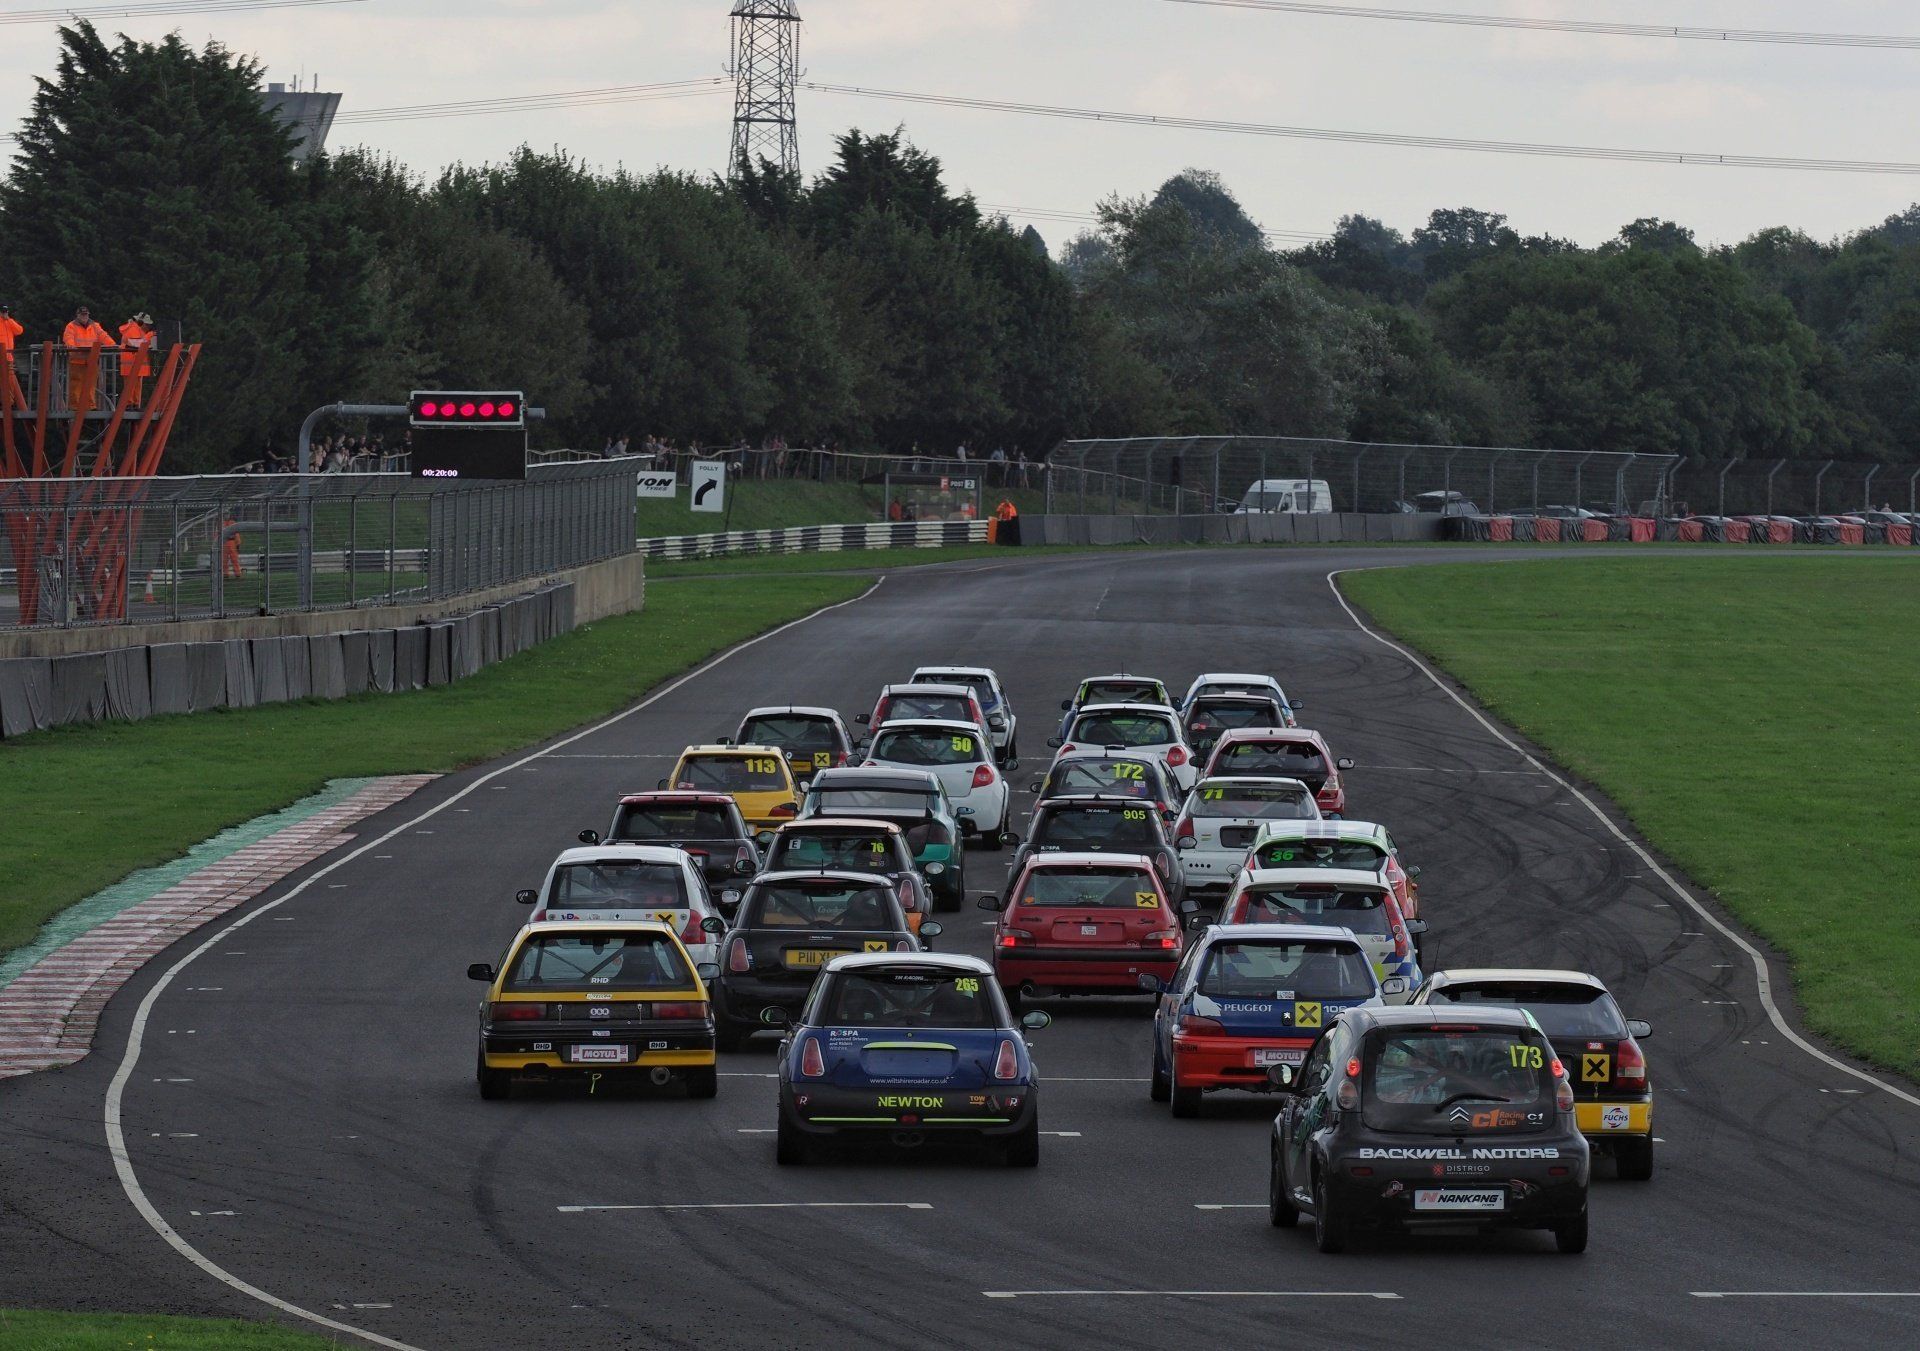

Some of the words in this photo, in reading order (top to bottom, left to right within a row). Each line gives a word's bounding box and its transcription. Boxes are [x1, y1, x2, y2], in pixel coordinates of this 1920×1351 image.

[422, 469, 458, 477] 00:20:00
[952, 737, 972, 753] 50
[745, 758, 776, 774] 113
[1113, 763, 1144, 780] 172
[1123, 810, 1146, 820] 905
[871, 842, 885, 853] 76
[1270, 850, 1294, 862] 36
[955, 978, 979, 992] 265
[1224, 1004, 1273, 1012] PEUGEOT
[583, 1050, 616, 1058] MOTUL
[1266, 1051, 1300, 1061] MOTUL
[1510, 1045, 1543, 1069] 173
[878, 1096, 943, 1108] NEWTON
[1500, 1111, 1525, 1120] Racing
[1359, 1148, 1466, 1159] BACKWELL
[1472, 1148, 1560, 1159] MOTORS
[1438, 1195, 1499, 1203] NANKANG
